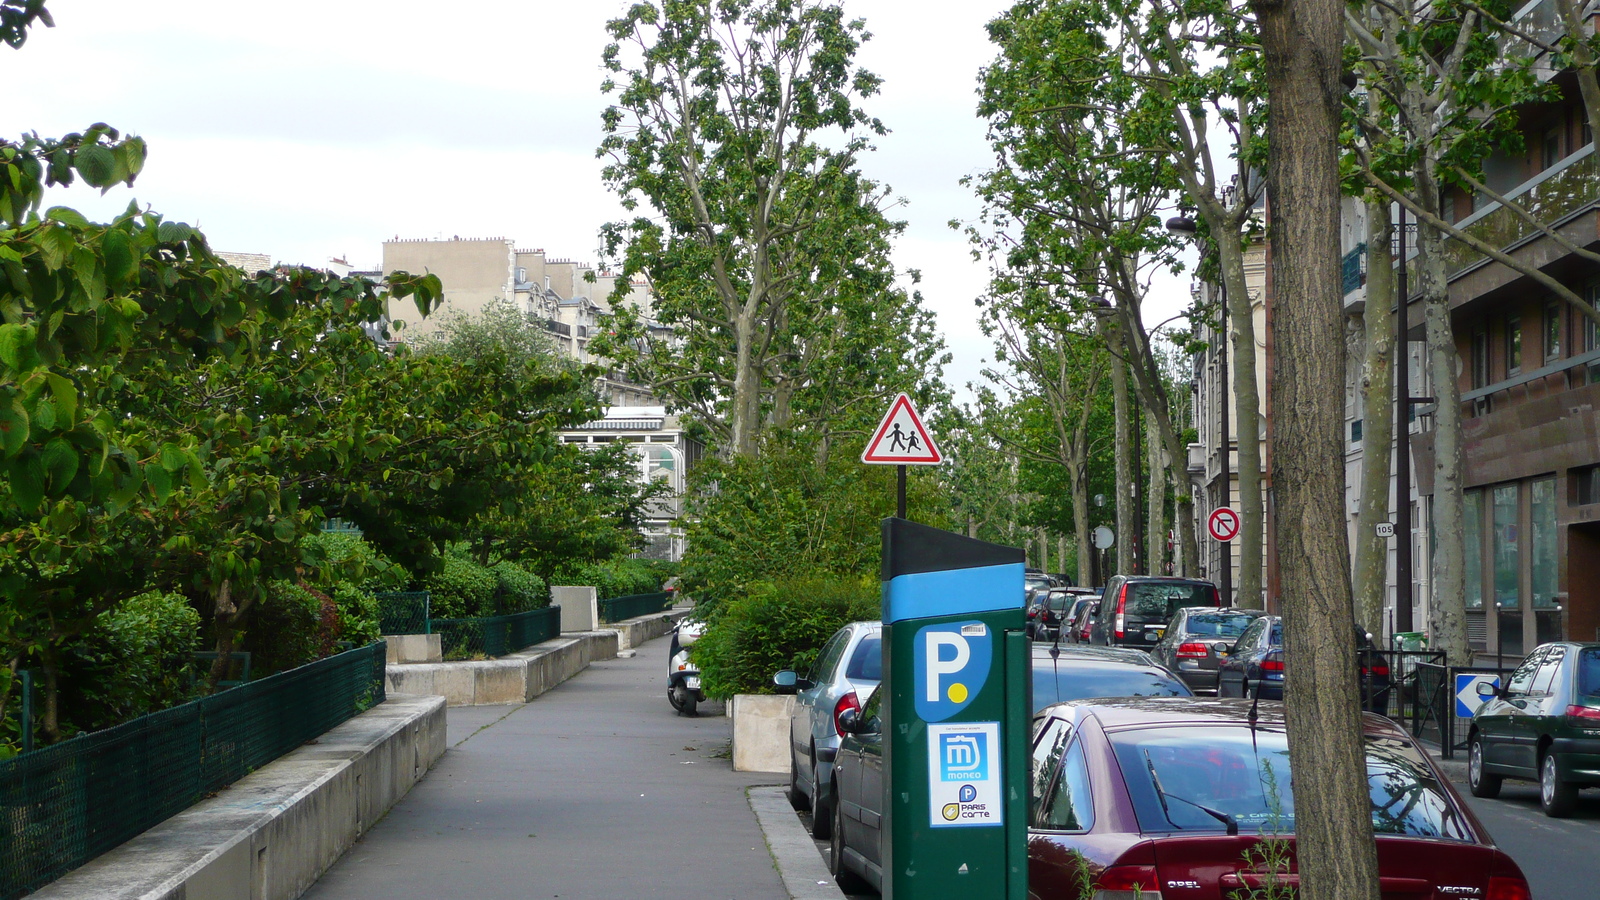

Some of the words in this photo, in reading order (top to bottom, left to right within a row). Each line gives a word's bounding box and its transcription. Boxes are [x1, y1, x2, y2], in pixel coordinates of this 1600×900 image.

[1377, 525, 1392, 534] 105
[926, 631, 970, 702] P
[964, 788, 973, 800] P
[961, 803, 986, 811] PARIS
[1167, 880, 1201, 888] OPEL
[1436, 885, 1482, 894] VECTRA
